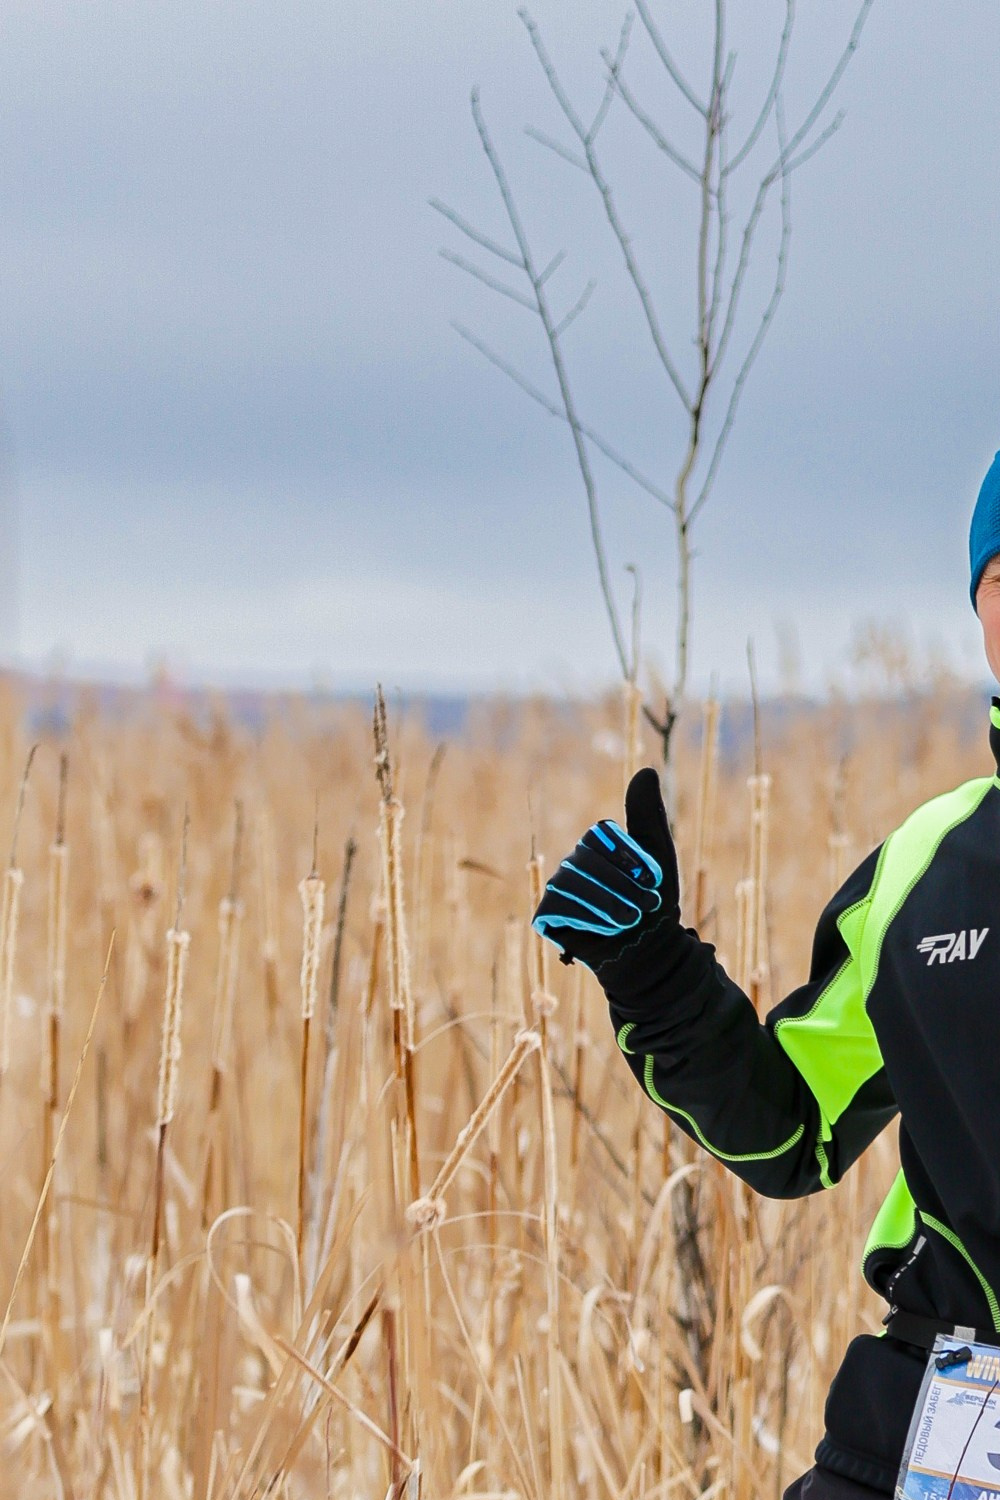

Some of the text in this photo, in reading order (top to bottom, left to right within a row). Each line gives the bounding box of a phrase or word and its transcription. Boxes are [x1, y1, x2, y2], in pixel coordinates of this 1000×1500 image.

[917, 927, 990, 967] RAY
[913, 1383, 942, 1465] ЛЕДОВЫЙ ЗАБЕГ
